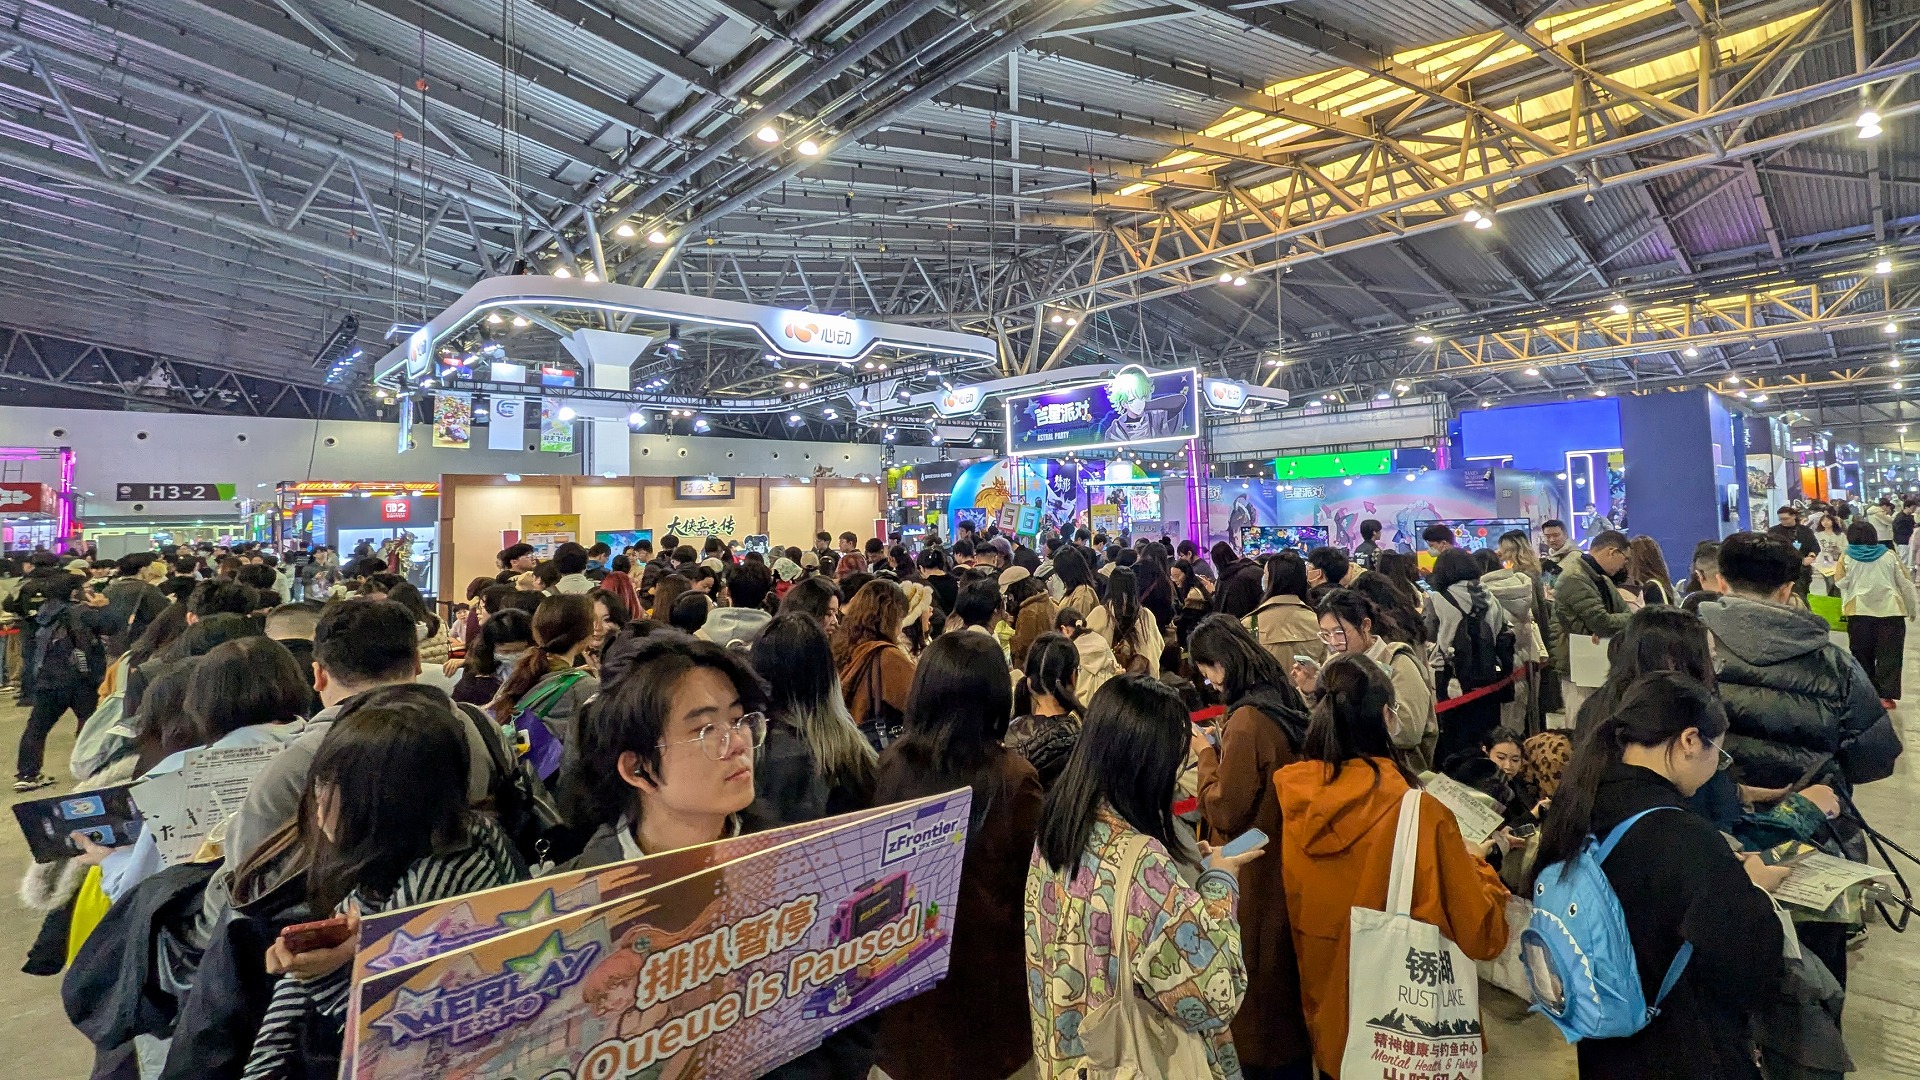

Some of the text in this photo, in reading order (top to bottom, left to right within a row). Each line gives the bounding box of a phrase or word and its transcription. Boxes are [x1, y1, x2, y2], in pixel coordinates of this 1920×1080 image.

[820, 328, 852, 345] 心动
[958, 393, 974, 404] 心动
[1035, 398, 1090, 427] 吉星派对
[1037, 431, 1070, 442] ASTRAL PARTY
[148, 486, 206, 499] H3-2
[398, 502, 406, 513] 2
[667, 515, 736, 536] 大侠立志传
[888, 820, 958, 854] zFrontier
[646, 898, 815, 1001] 排队暂停
[1405, 946, 1455, 987] 锈湖
[391, 941, 601, 1037] WEPLAY
[583, 905, 919, 1080] Queue is Paused
[1398, 985, 1466, 1008] RUST LAKE
[451, 992, 543, 1043] EXPO
[1374, 1031, 1478, 1058] 精神健康与钓鱼中心
[1371, 1049, 1411, 1070] Mental
[1414, 1059, 1442, 1072] Health
[1445, 1058, 1452, 1070] &
